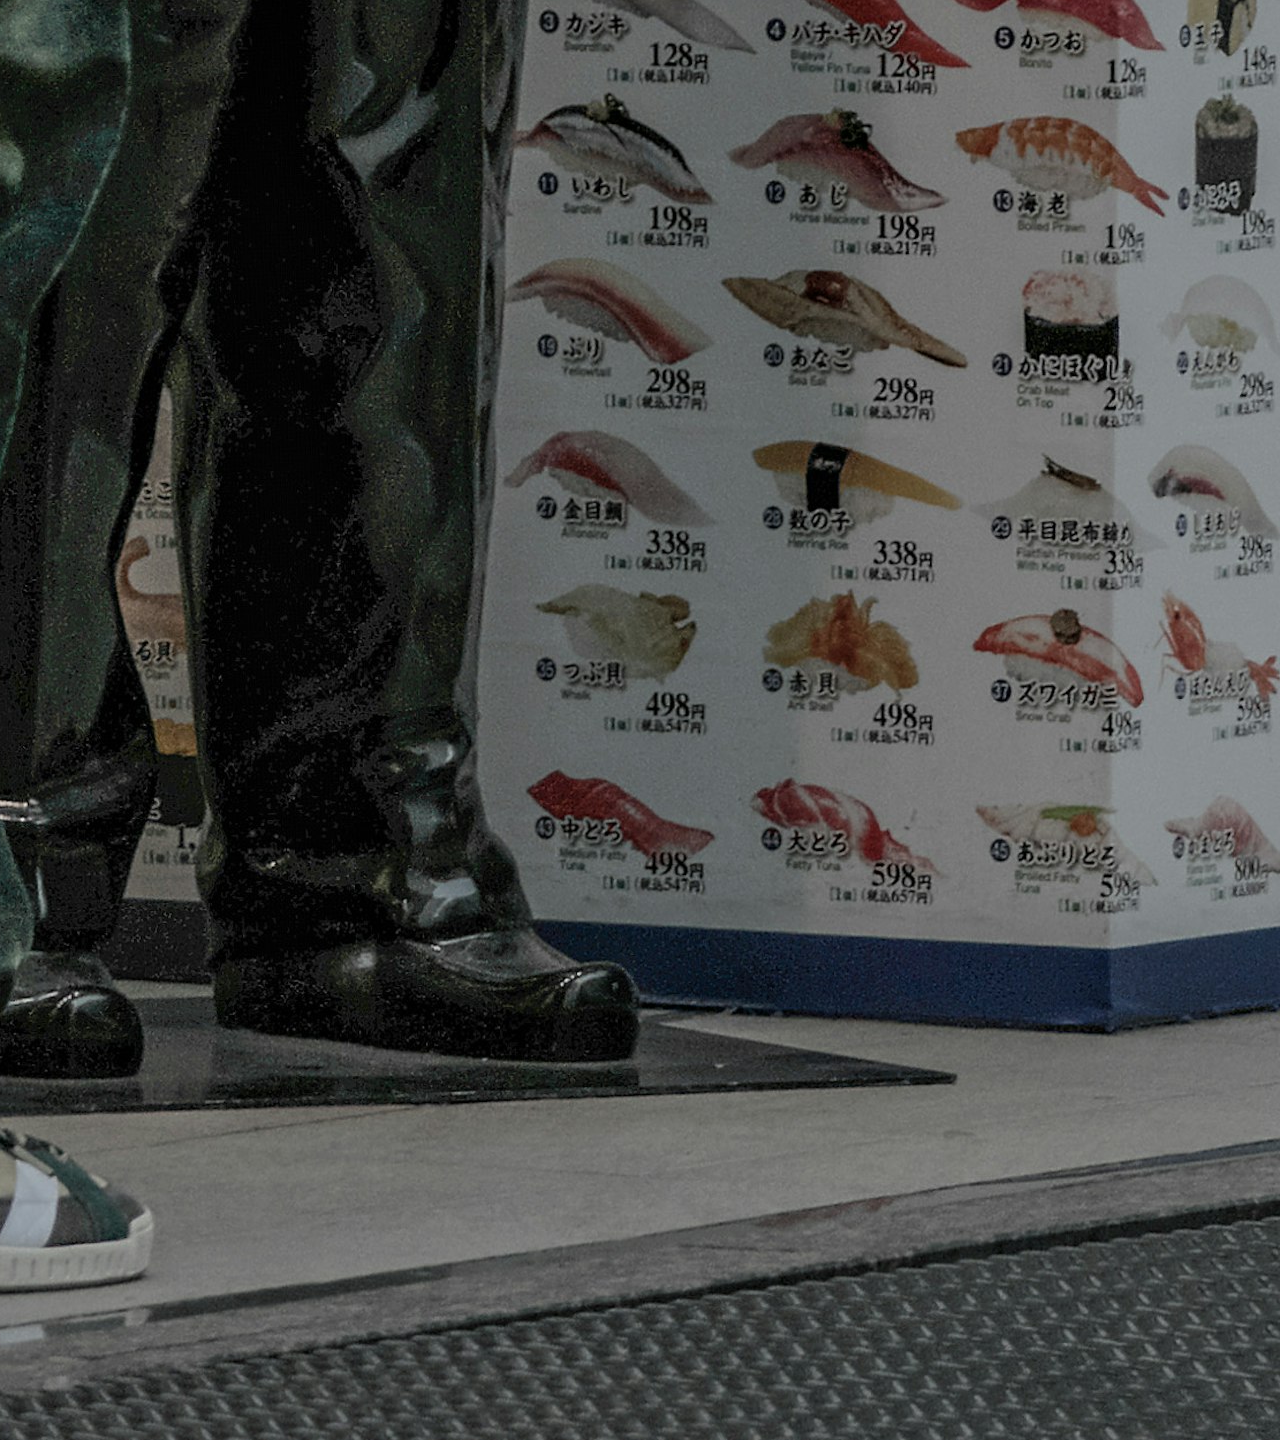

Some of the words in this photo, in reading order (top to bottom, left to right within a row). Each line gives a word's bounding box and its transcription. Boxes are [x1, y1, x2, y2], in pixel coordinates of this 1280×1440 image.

[566, 14, 625, 35] カジキ
[1021, 30, 1083, 52] かつお
[650, 42, 708, 70] 128円
[877, 53, 936, 79] 128円
[1107, 58, 1146, 83] 128円
[571, 176, 633, 200] いわし
[798, 182, 849, 208] あじ
[1019, 191, 1066, 214] 海老
[650, 206, 708, 234] 198円
[876, 214, 935, 241] 198円
[562, 337, 603, 363] ぶり
[790, 347, 854, 371] あなご
[646, 369, 706, 397] 298円
[873, 377, 934, 406] 298円
[789, 508, 851, 532] 数の子
[646, 530, 706, 557] 338円
[872, 540, 933, 568] 338円
[562, 660, 623, 686] つぶ貝
[789, 672, 836, 696] 赤貝
[645, 692, 706, 720] 498円
[1020, 681, 1118, 707] ズワイガニ
[872, 703, 933, 730] 498円
[560, 821, 621, 844] 中とろ
[789, 831, 849, 855] 大とろ
[644, 852, 705, 879] 498円
[1018, 842, 1117, 868] あぶりとろ
[871, 863, 932, 890] 598円
